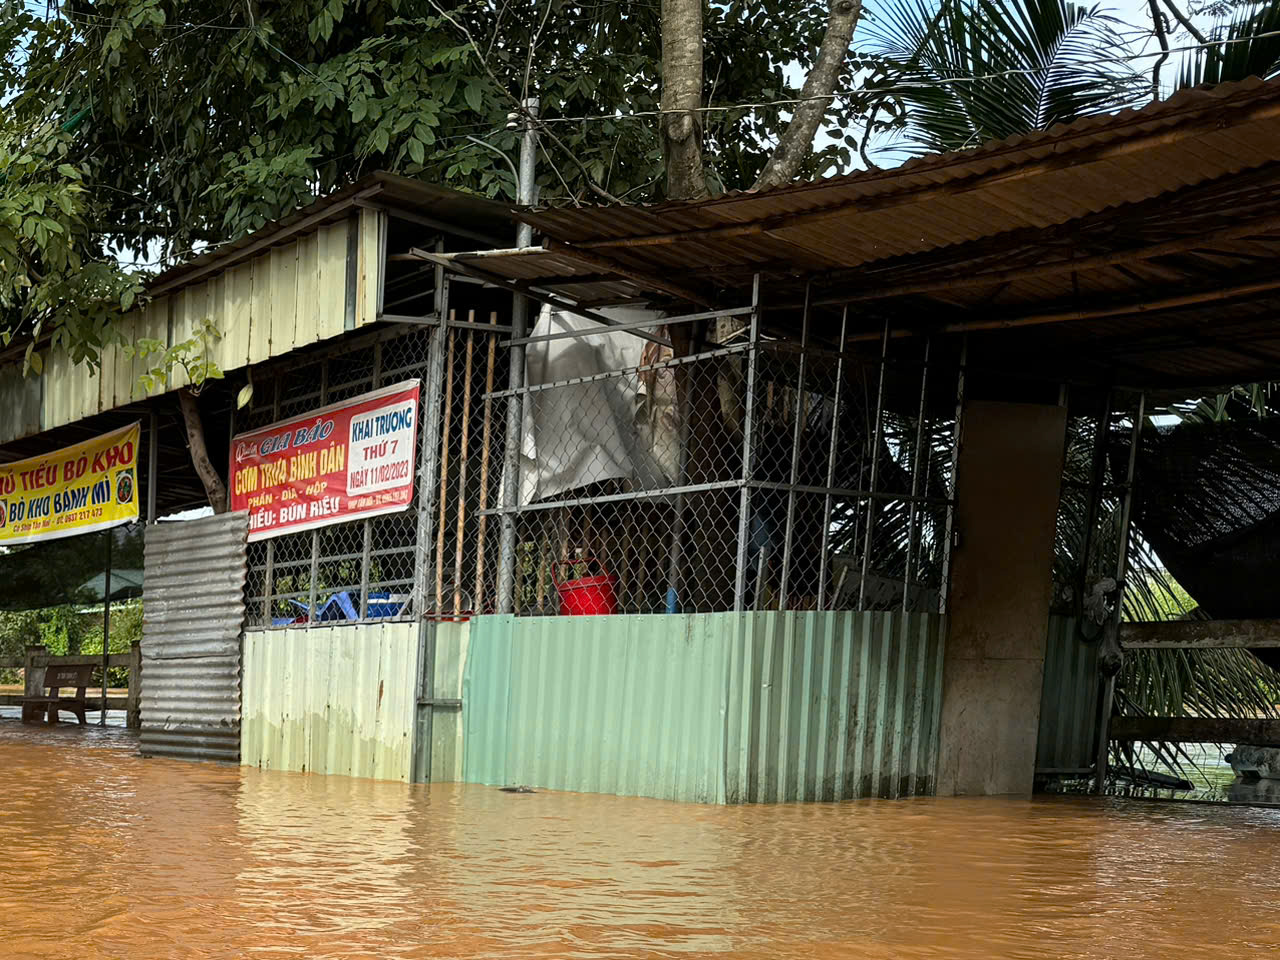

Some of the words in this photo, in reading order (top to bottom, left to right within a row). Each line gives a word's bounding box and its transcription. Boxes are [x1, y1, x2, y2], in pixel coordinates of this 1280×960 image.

[260, 432, 292, 456] GIA
[293, 418, 334, 448] BẢO
[352, 417, 375, 443] KHAI
[63, 451, 89, 482] BÒ
[92, 441, 134, 474] KHO
[235, 465, 258, 496] CƠM
[260, 456, 287, 489] TRƯA
[289, 449, 317, 483] BÌNH
[320, 441, 345, 476] DÂN
[362, 440, 386, 462] THỨ
[390, 440, 399, 455] 7
[350, 465, 369, 490] NGÀY
[370, 460, 409, 486] 11/02/2023
[8, 496, 25, 522] BÒ
[27, 495, 51, 519] KHO
[54, 486, 90, 514] BÁNH
[92, 475, 111, 505] MÌ
[248, 507, 277, 530] HIỀU:
[280, 499, 307, 523] BÚN
[310, 495, 340, 518] RIÊU
